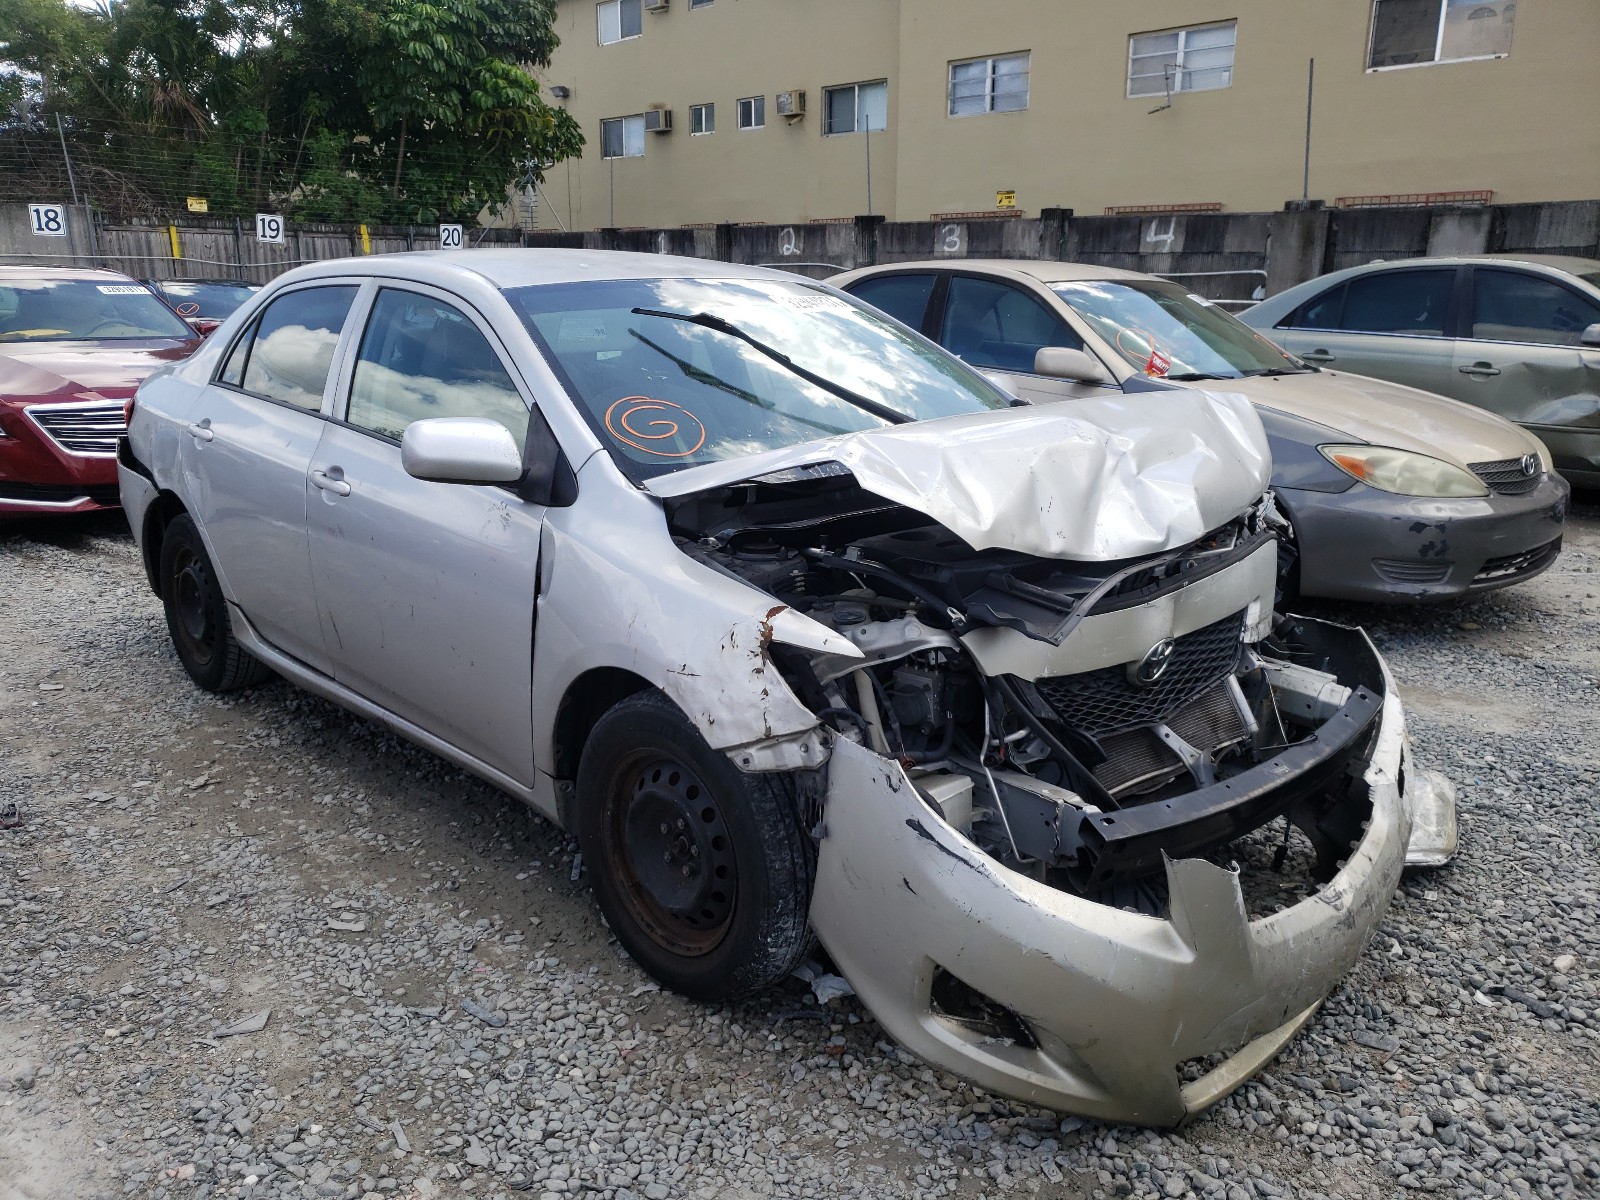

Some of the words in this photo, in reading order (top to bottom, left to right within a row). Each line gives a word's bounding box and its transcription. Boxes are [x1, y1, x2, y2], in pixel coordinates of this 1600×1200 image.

[33, 208, 62, 231] 18
[260, 218, 280, 239] 19
[443, 228, 460, 246] 20
[780, 227, 800, 255] 2
[942, 224, 960, 251] 3
[1146, 216, 1176, 252] 4
